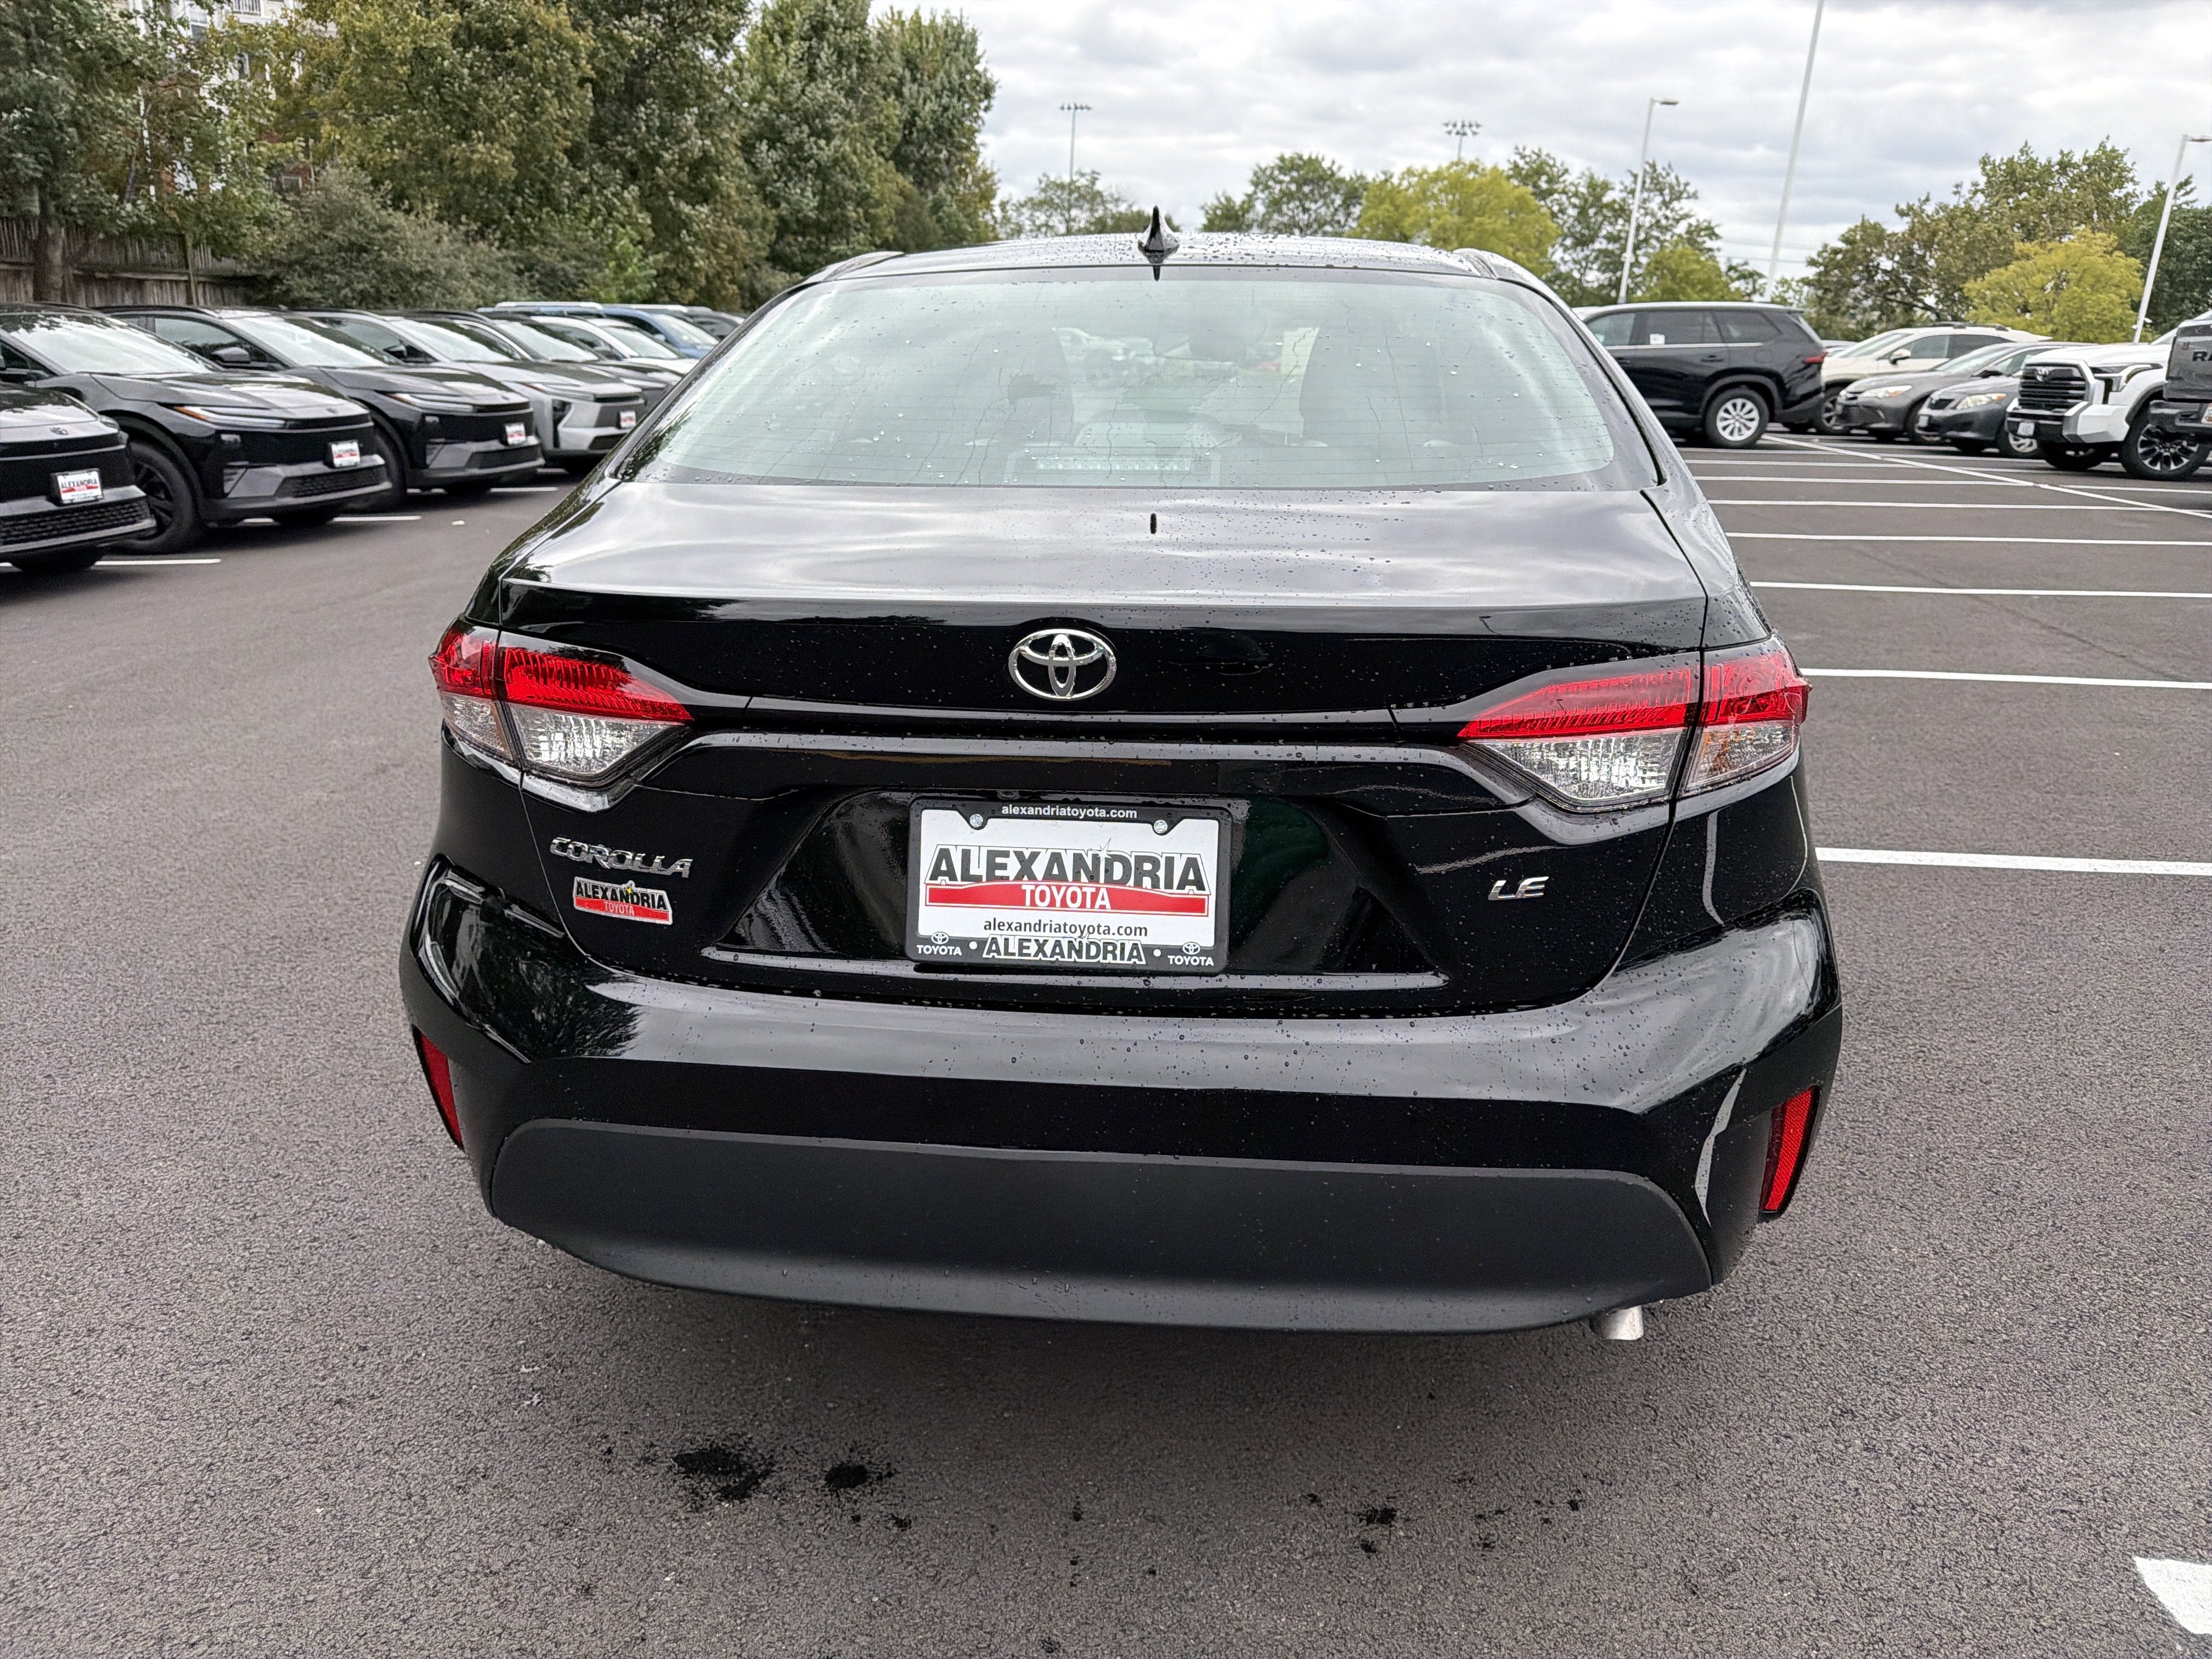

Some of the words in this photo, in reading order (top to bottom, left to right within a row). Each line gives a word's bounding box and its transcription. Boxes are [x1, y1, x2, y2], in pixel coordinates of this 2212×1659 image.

[1001, 804, 1137, 819] alexandriatoyota.com
[550, 837, 693, 878] COROLLA
[928, 847, 1206, 892] ALEXANDRIA
[576, 881, 669, 911] ALEXANDRIA
[1021, 884, 1111, 910] TOYOTA
[1488, 876, 1549, 901] LE
[604, 900, 635, 916] TOYOTA
[983, 917, 1148, 937] alexandriatoyota.com
[916, 944, 962, 957] TOYOTA
[983, 935, 1147, 965] ALEXANDRIA
[1167, 955, 1214, 967] TOYOTA
